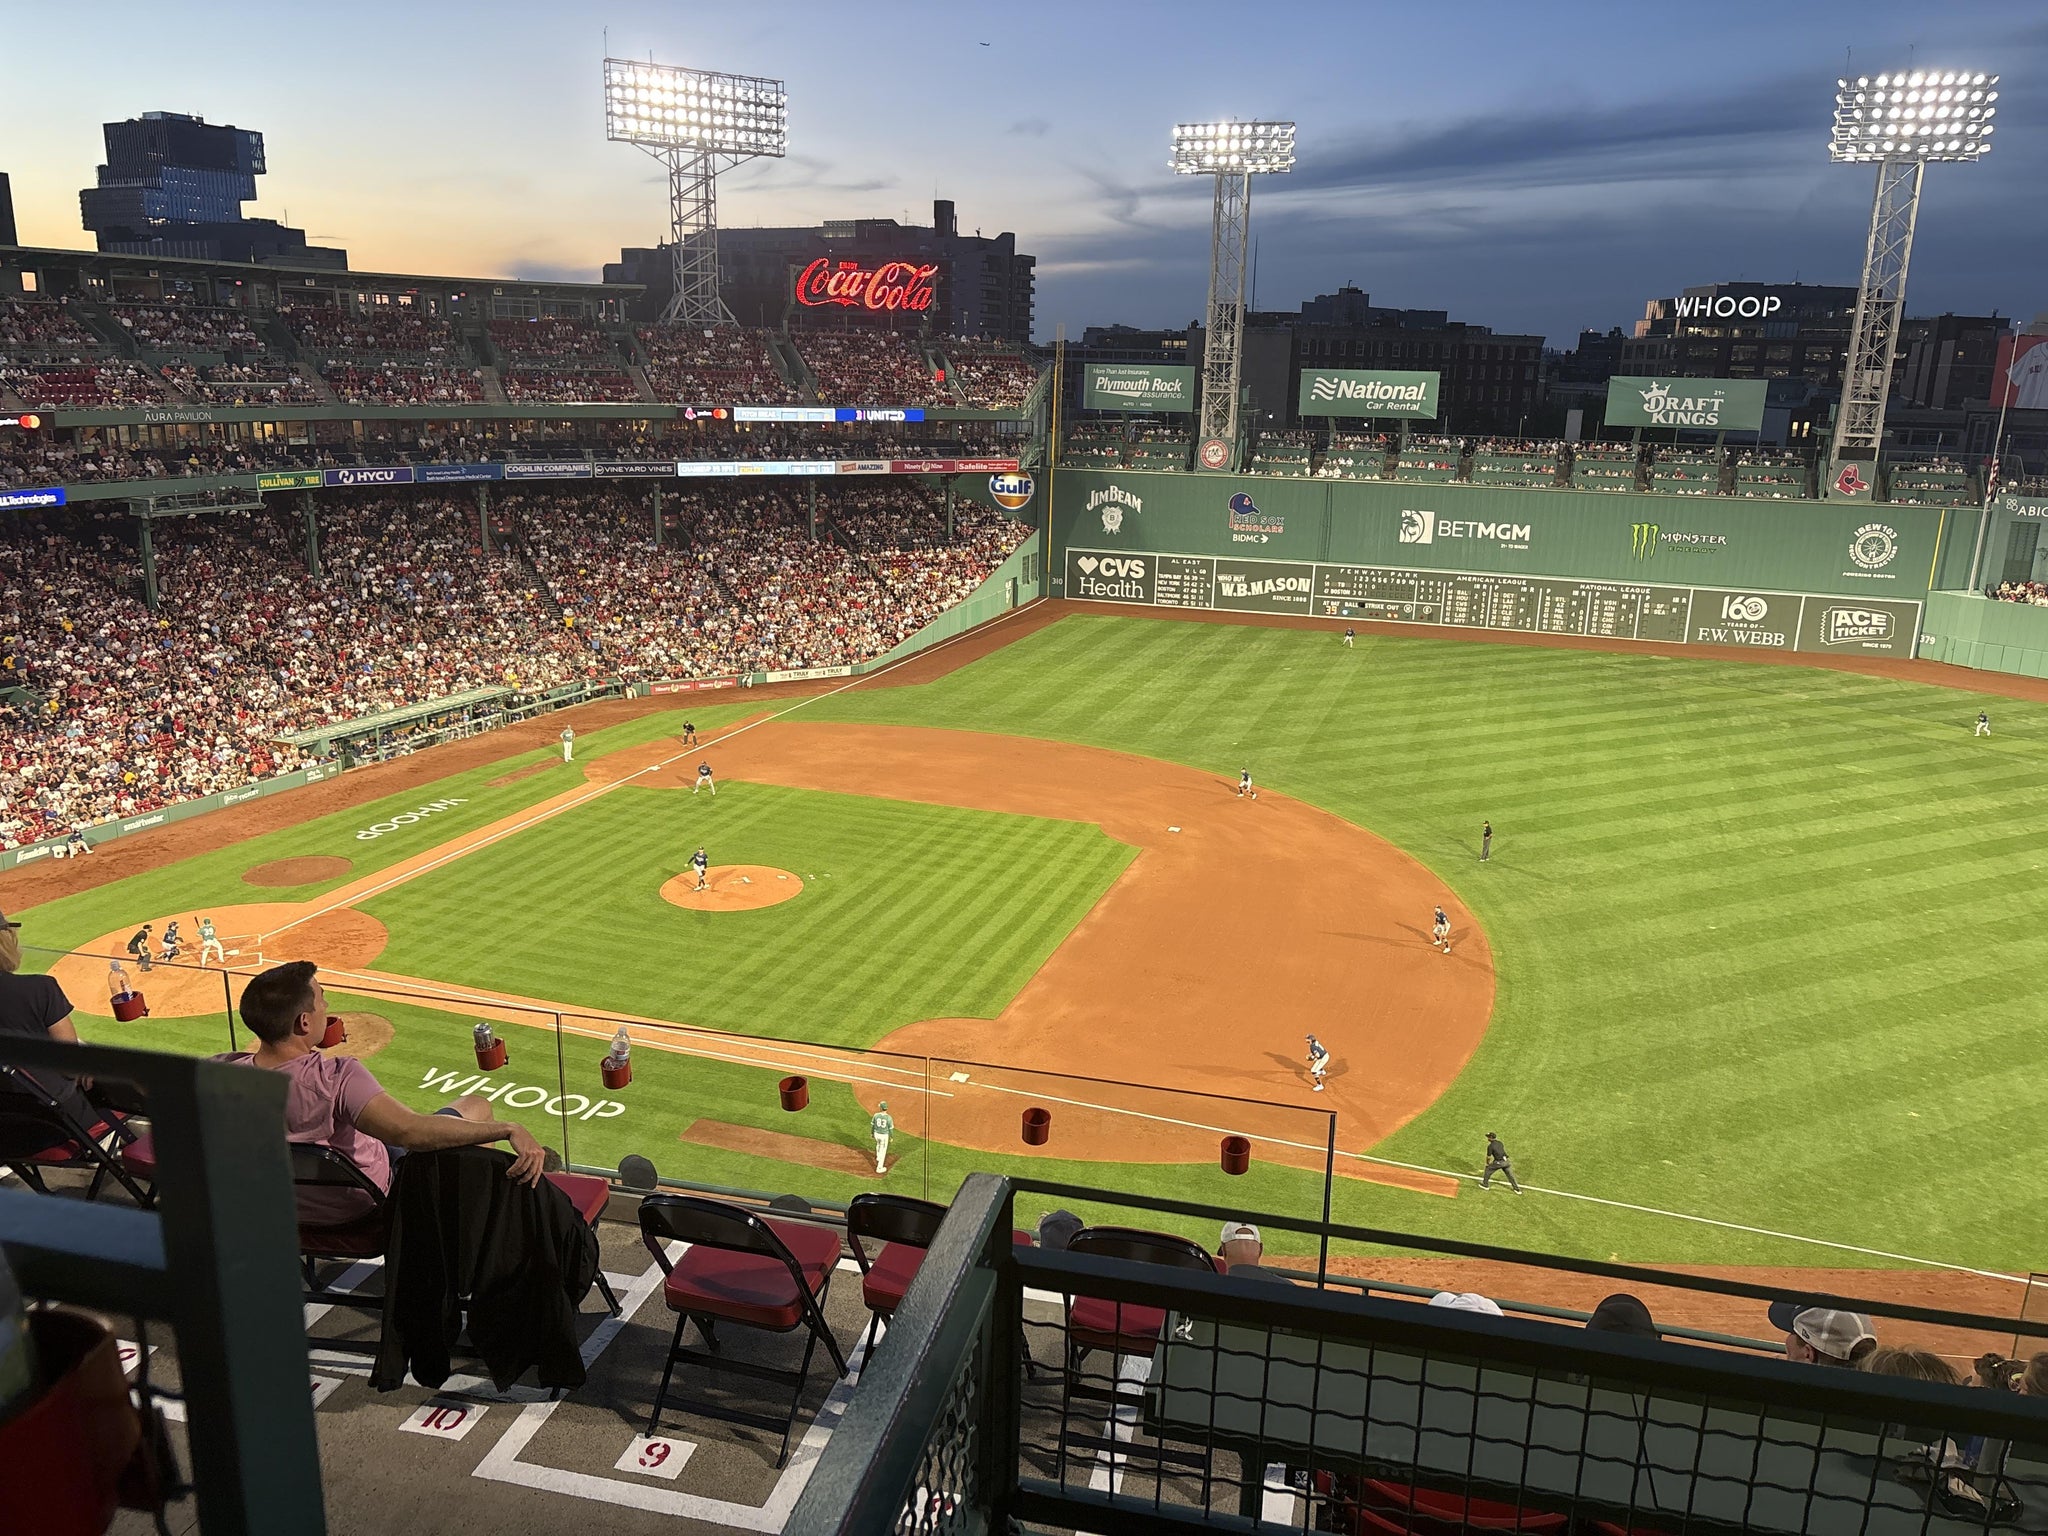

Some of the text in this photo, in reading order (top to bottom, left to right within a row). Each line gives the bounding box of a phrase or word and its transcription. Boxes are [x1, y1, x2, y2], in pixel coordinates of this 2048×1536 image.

[796, 258, 938, 310] Coca-Cola
[1674, 296, 1781, 318] WHOOP
[1096, 376, 1182, 392] Plymouth Rock
[1366, 402, 1420, 410] Car Rental
[1643, 396, 1724, 412] DRAFT
[174, 411, 212, 420] PAVILION
[866, 410, 906, 420] UNITED
[1651, 410, 1719, 426] KINGS
[544, 464, 590, 472] COMPANIES
[260, 476, 320, 488] SULLIVAN TIRE
[357, 471, 394, 482] HYCU
[991, 479, 1032, 494] Gulf
[1086, 484, 1143, 514] JIM BEAM
[1233, 514, 1284, 526] RED SOX
[1232, 524, 1284, 534] SCHOLARS
[1438, 520, 1531, 541] BETMGM
[1854, 524, 1898, 539] IBEW 103
[1232, 534, 1260, 543] BIDMC
[1660, 532, 1727, 545] MONSTER
[1100, 558, 1145, 578] CVS
[1340, 568, 1383, 576] FENWAY
[1079, 577, 1144, 598] Health
[1580, 584, 1618, 592] NATIONAL
[1722, 595, 1768, 621] 160
[1836, 610, 1887, 626] ACE
[1697, 628, 1785, 646] F.W. WEBB
[1836, 626, 1886, 638] TICKET
[1920, 634, 1936, 645] 379
[124, 814, 164, 831] smartwater
[356, 798, 469, 840] WHOOP
[418, 1067, 626, 1120] WHOOP
[876, 1118, 888, 1128] 83
